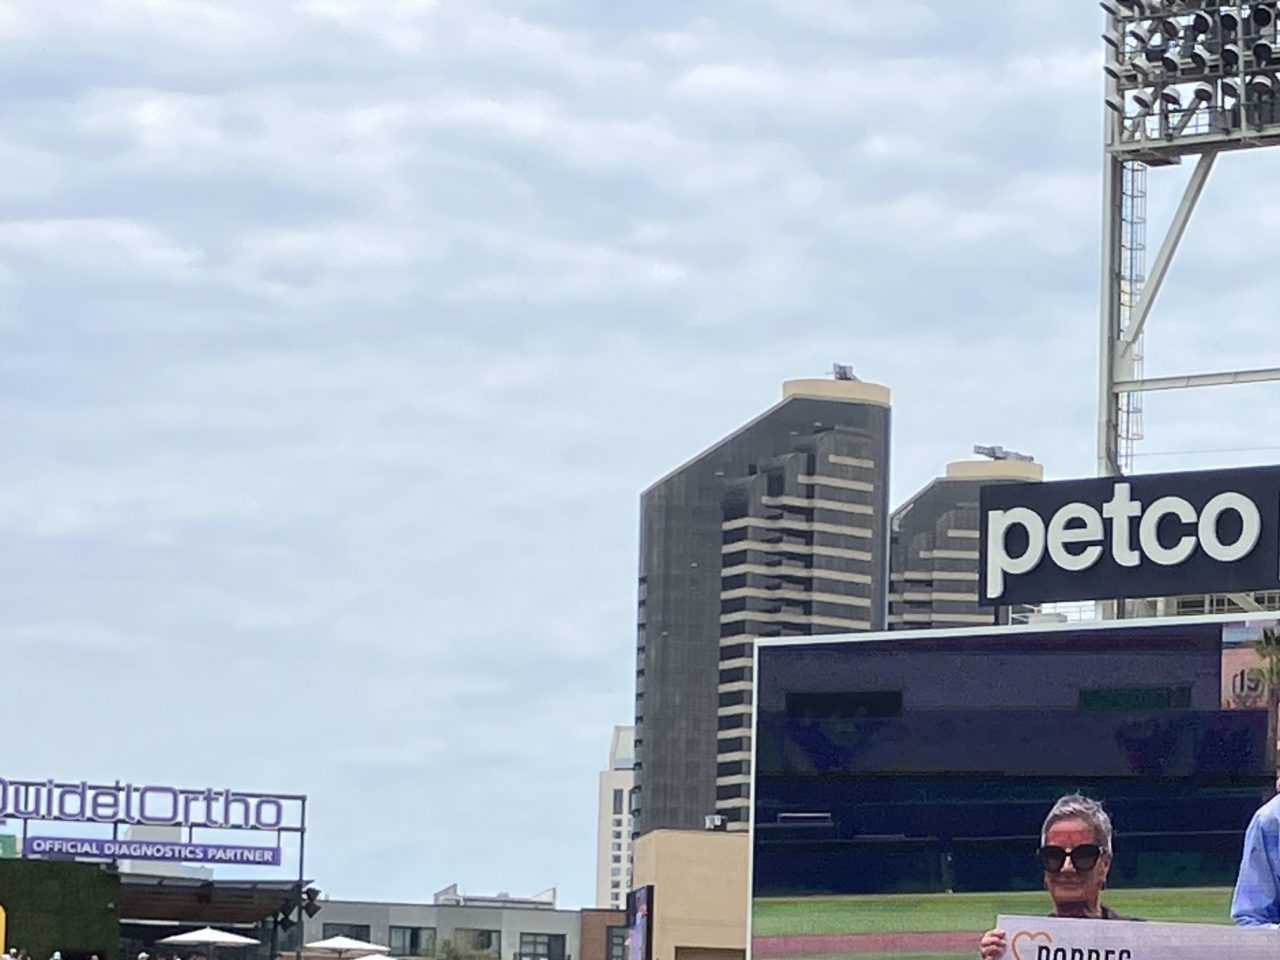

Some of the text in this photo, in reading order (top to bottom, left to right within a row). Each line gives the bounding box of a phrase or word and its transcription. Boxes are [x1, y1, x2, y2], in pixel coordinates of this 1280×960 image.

[987, 483, 1260, 598] petco
[0, 778, 282, 829] uidelOrtho
[32, 839, 273, 862] OFFICIAL DIAGNOSTICS PARTNER
